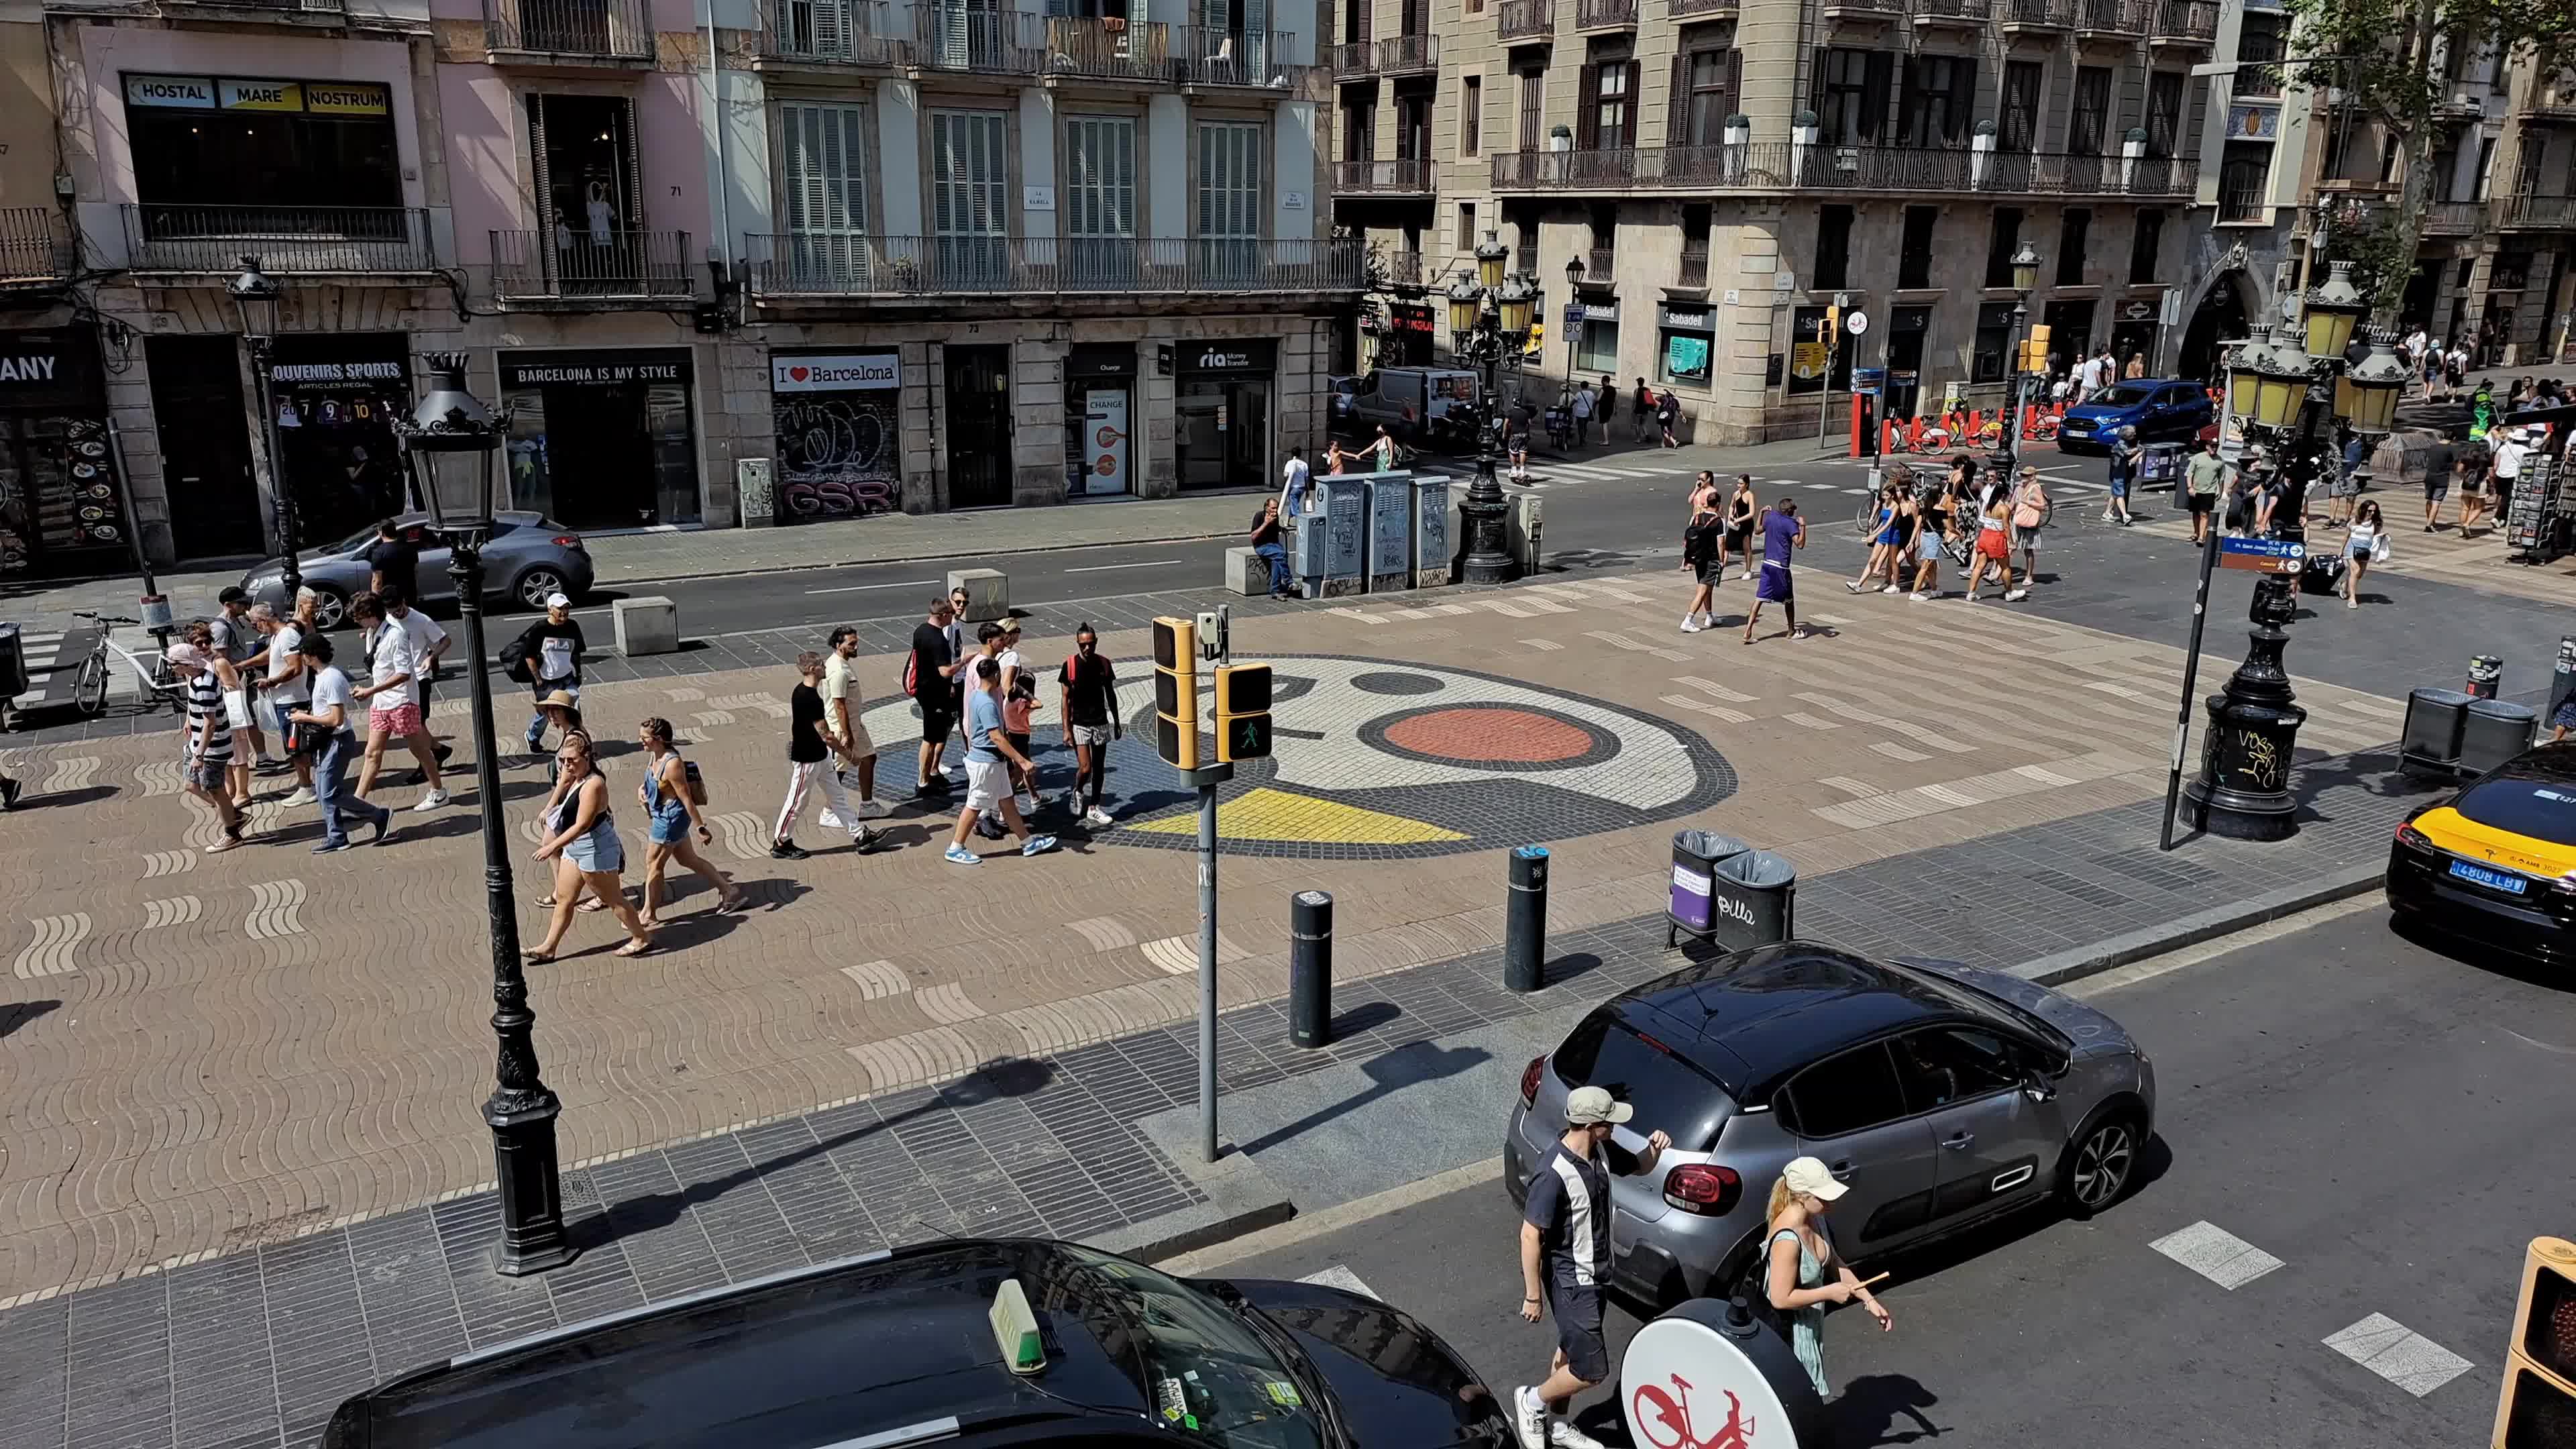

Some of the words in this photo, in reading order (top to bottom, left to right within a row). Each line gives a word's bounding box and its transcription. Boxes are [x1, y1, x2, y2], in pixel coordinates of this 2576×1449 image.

[142, 83, 207, 100] HOSTAL
[236, 87, 283, 103] MARE
[309, 91, 384, 107] NOSTRUM
[670, 186, 682, 197] 71
[1585, 305, 1615, 318] Sabadell
[1669, 313, 1703, 327] Sabadell
[967, 323, 979, 333] 73
[1199, 347, 1226, 368] ria
[1226, 352, 1246, 361] Money
[0, 356, 55, 381] ANY
[270, 364, 344, 381] OUVENIRS
[345, 362, 401, 379] SPORTS
[518, 368, 592, 382] BARCELONA
[597, 367, 610, 380] IS
[614, 366, 634, 380] MY
[639, 366, 678, 379] STYLE
[779, 366, 788, 384] I
[811, 364, 895, 383] Barcelona
[343, 381, 374, 389] REGAL
[354, 403, 370, 419] 10
[1089, 400, 1123, 409] CHANGE
[546, 639, 570, 650] FILA
[2460, 865, 2494, 883] 4808
